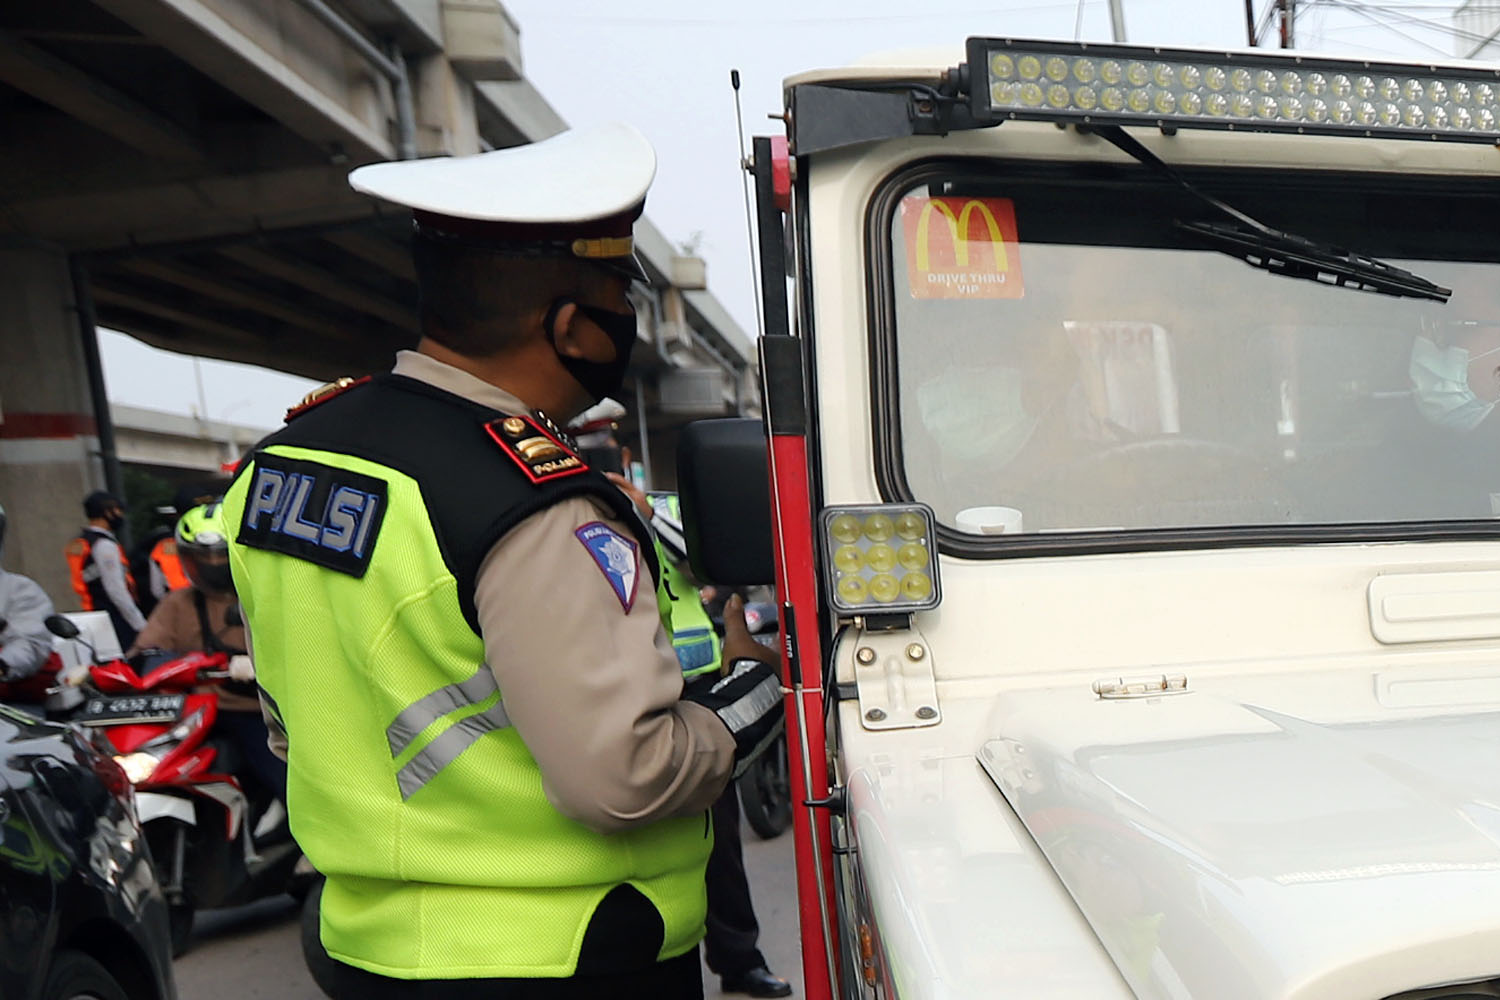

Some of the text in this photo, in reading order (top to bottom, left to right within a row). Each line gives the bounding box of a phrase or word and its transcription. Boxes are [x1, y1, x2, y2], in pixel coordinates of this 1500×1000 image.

[927, 273, 1006, 285] DRIVE THRU
[957, 284, 979, 293] VIP
